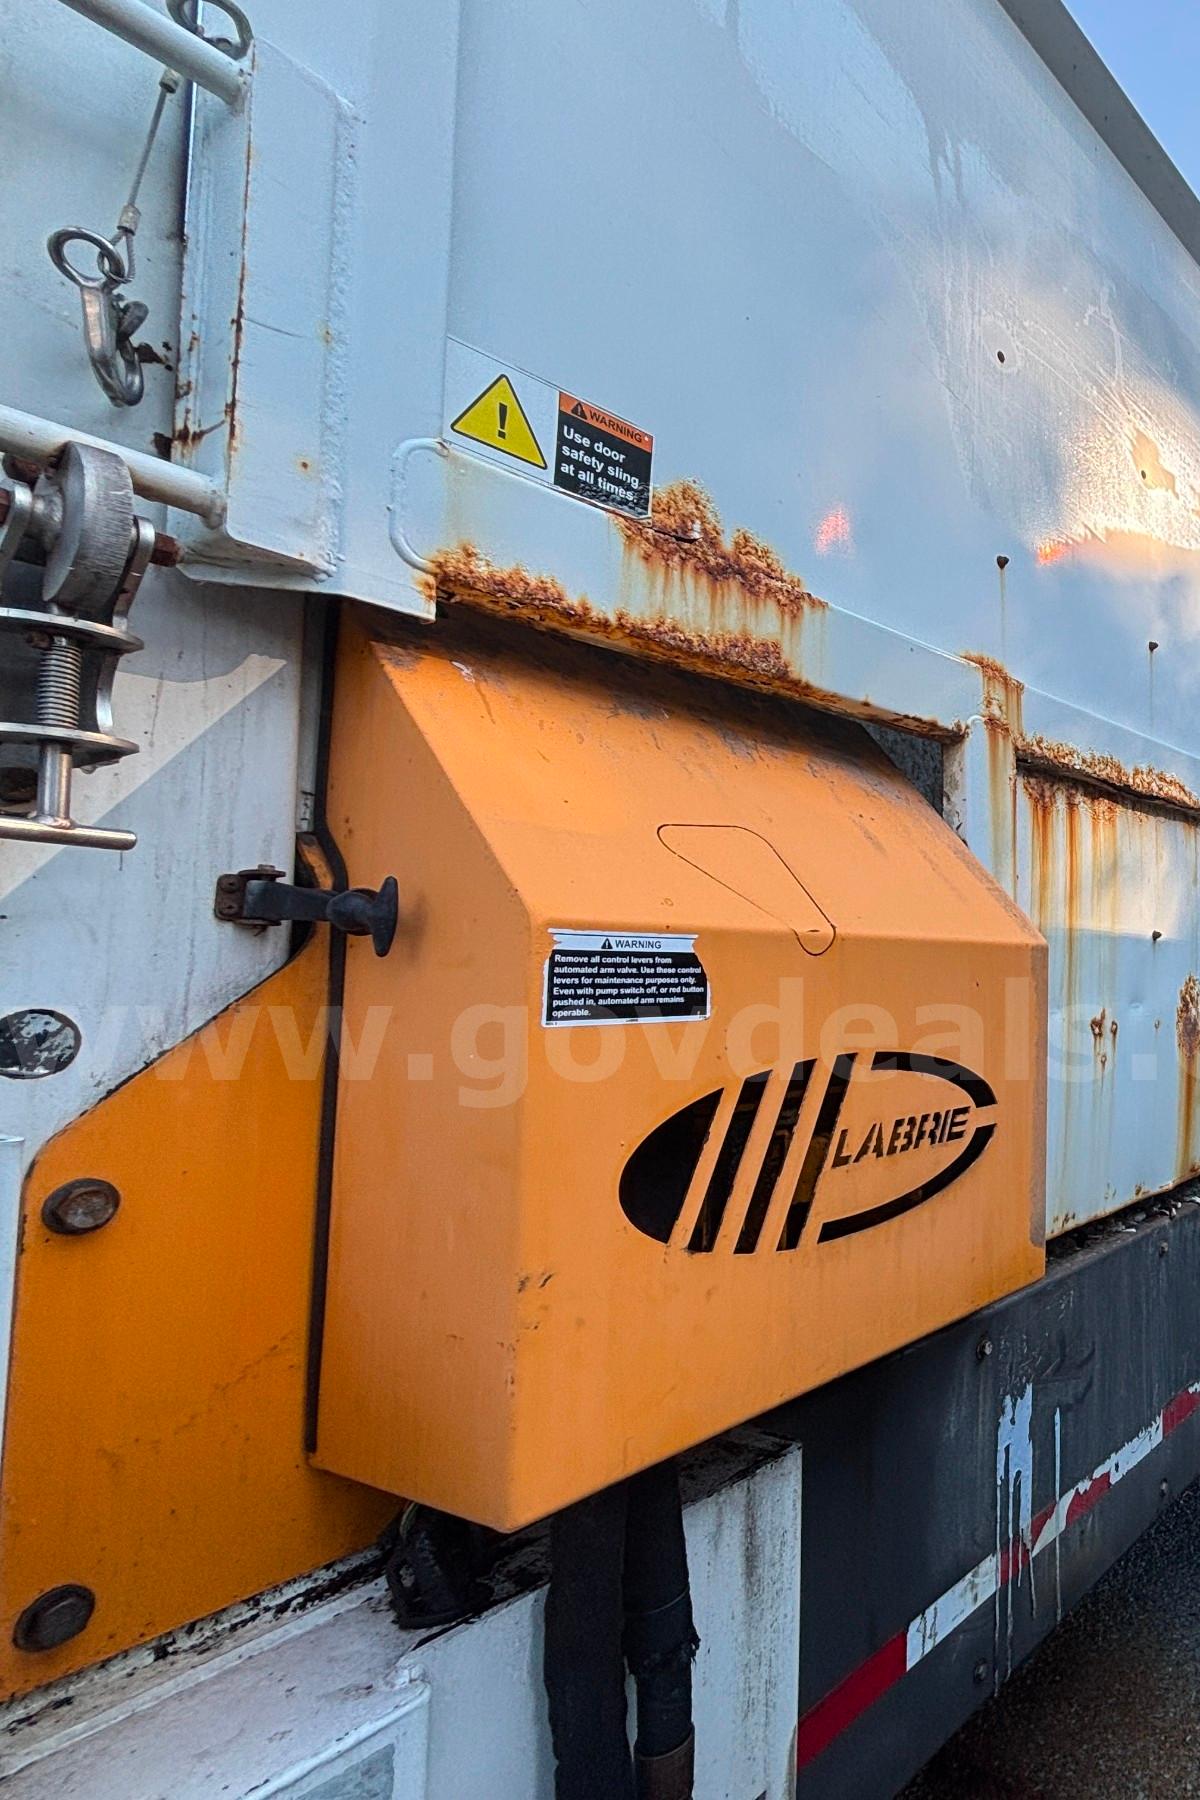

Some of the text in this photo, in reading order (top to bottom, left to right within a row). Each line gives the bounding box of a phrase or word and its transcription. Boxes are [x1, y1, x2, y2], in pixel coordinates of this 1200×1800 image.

[590, 409, 643, 443] WARNING
[563, 425, 626, 463] Use door
[562, 444, 639, 489] safety sling
[560, 462, 638, 503] at all times.
[615, 940, 662, 949] WARNING
[555, 955, 588, 963] Remove
[602, 956, 629, 964] control
[657, 966, 675, 974] these
[554, 976, 579, 984] levers
[581, 976, 593, 984] for
[646, 986, 658, 994] off,
[553, 998, 584, 1007] pushed
[586, 998, 595, 1006] in,
[598, 997, 638, 1005] automated
[552, 1009, 591, 1018] operable.
[831, 1105, 971, 1170] LABRIE
